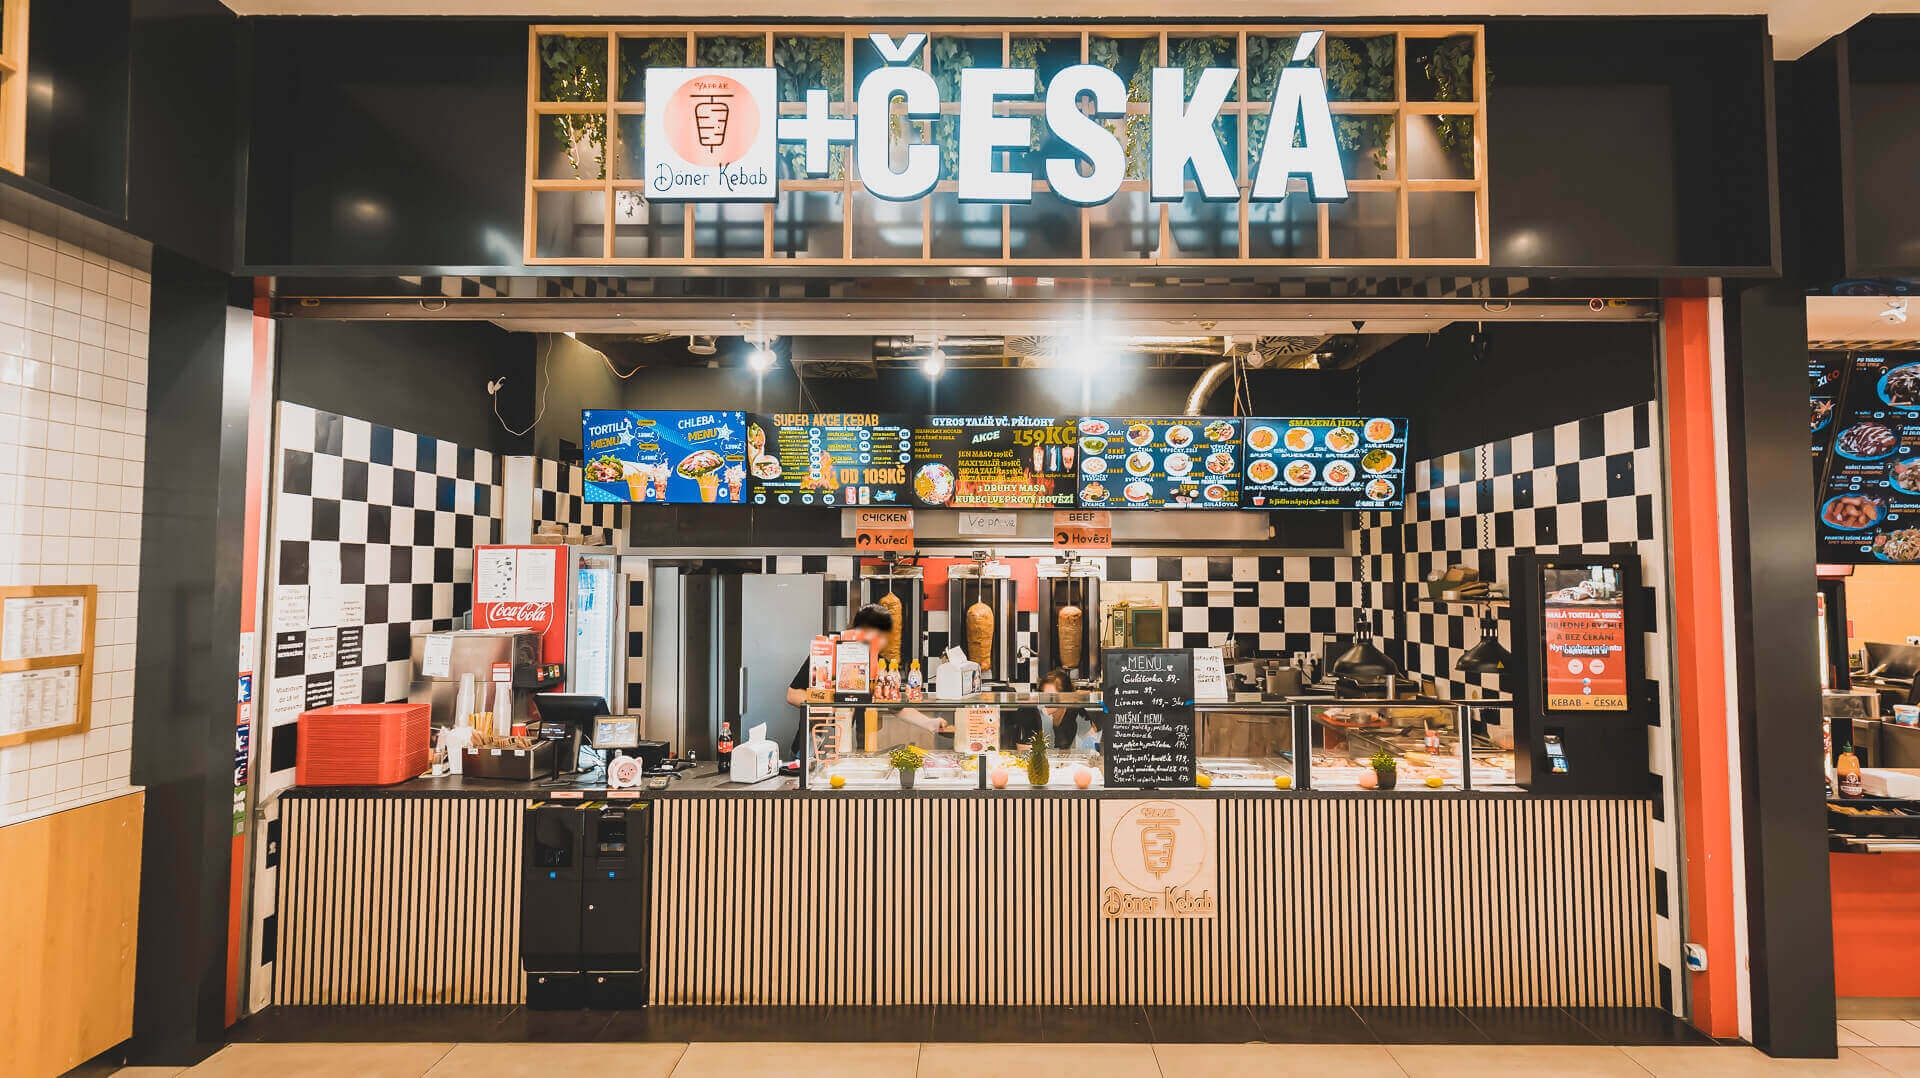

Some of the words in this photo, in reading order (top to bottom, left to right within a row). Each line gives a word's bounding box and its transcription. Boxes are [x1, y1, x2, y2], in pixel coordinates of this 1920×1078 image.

[857, 31, 1349, 204] ČESKÁ
[653, 162, 711, 192] Döner
[719, 162, 769, 192] Kebab
[678, 414, 715, 430] CHLEBA
[773, 413, 809, 427] SUPER
[812, 413, 841, 427] AKCE
[843, 413, 879, 427] KEBAB
[932, 417, 966, 427] GYROS
[966, 415, 995, 427] TALÍŘ
[1011, 415, 1056, 427] PŘÍLOHY
[1288, 418, 1337, 427] SMAŽENÁ
[589, 420, 633, 436] TORTILLA
[687, 428, 718, 442] MENU
[1012, 420, 1077, 447] 159KČ
[591, 436, 620, 450] MENU
[971, 430, 1001, 444] AKCE
[958, 449, 971, 458] JEN
[971, 449, 993, 458] MASO
[840, 468, 859, 484] OD
[863, 465, 906, 484] 109KČ
[983, 483, 1018, 493] DRUHY
[1018, 483, 1046, 493] MASA
[862, 513, 908, 522] CHICKEN
[1069, 513, 1095, 522] BEEF
[875, 535, 909, 545] Kuřecí
[1072, 534, 1109, 544] Hovězí
[1565, 633, 1581, 641] BEZ
[1128, 656, 1162, 670] MENU
[1551, 698, 1582, 707] KEBAB
[1143, 714, 1162, 723] MENU
[1103, 886, 1160, 917] Döner
[1165, 885, 1214, 919] Kebab
